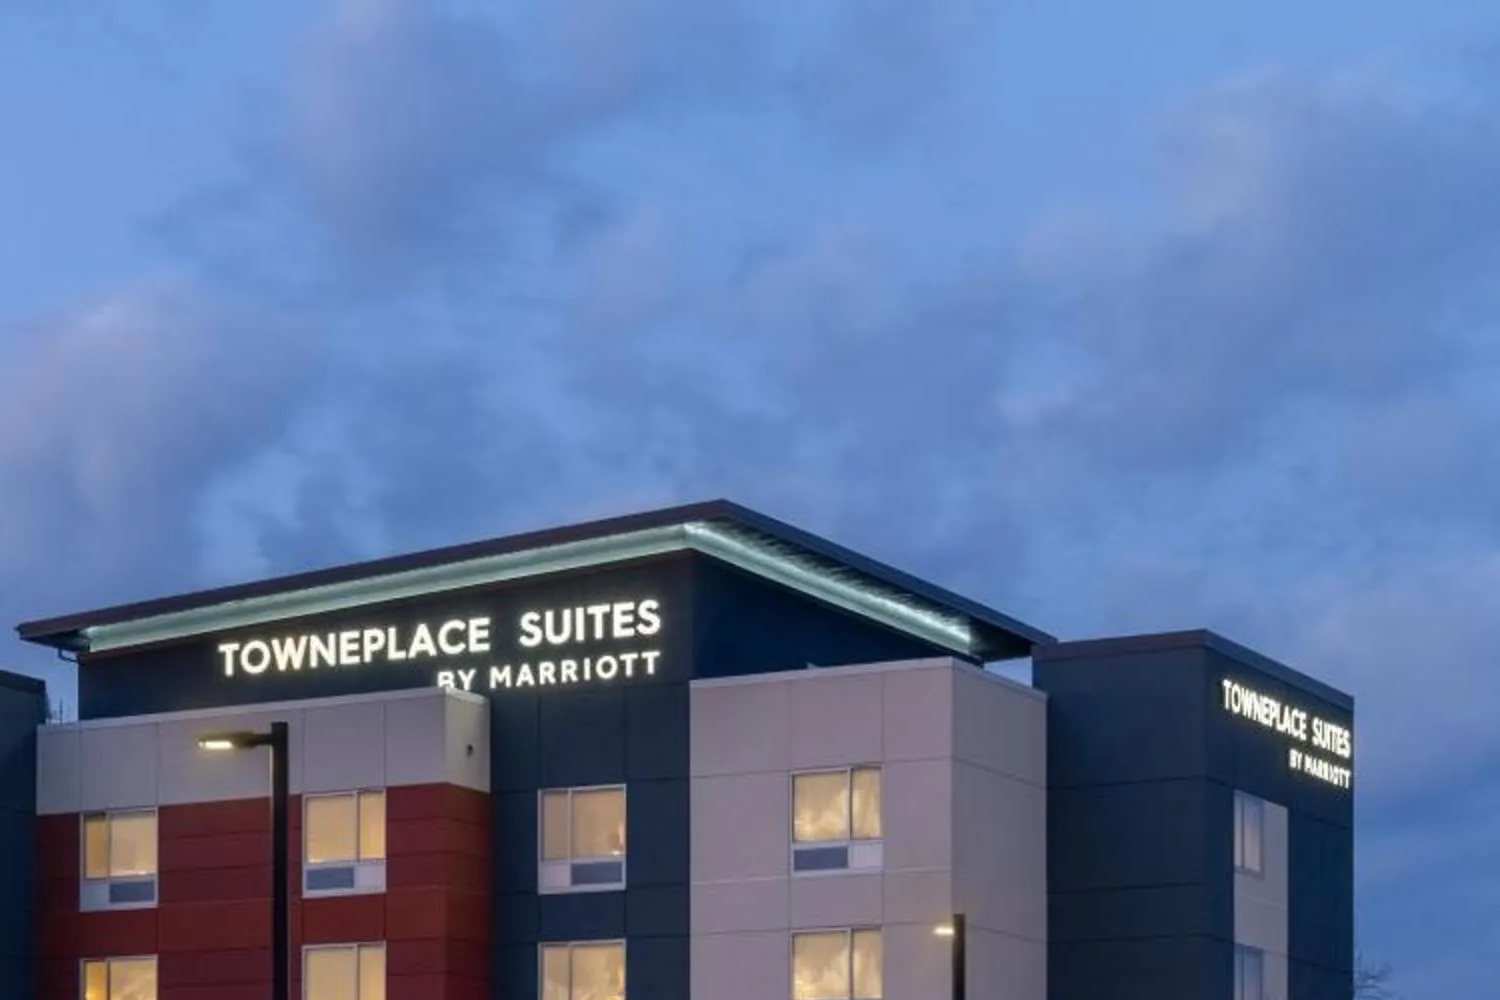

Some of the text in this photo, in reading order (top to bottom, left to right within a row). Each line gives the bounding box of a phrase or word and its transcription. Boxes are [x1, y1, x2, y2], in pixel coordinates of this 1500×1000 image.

[217, 598, 662, 677] TOWNEPLACE SUITES
[489, 650, 661, 689] MARRIOTT
[1222, 678, 1351, 759] TOWNEPLACE SUITES
[1289, 748, 1351, 789] BY MARRIOTT
